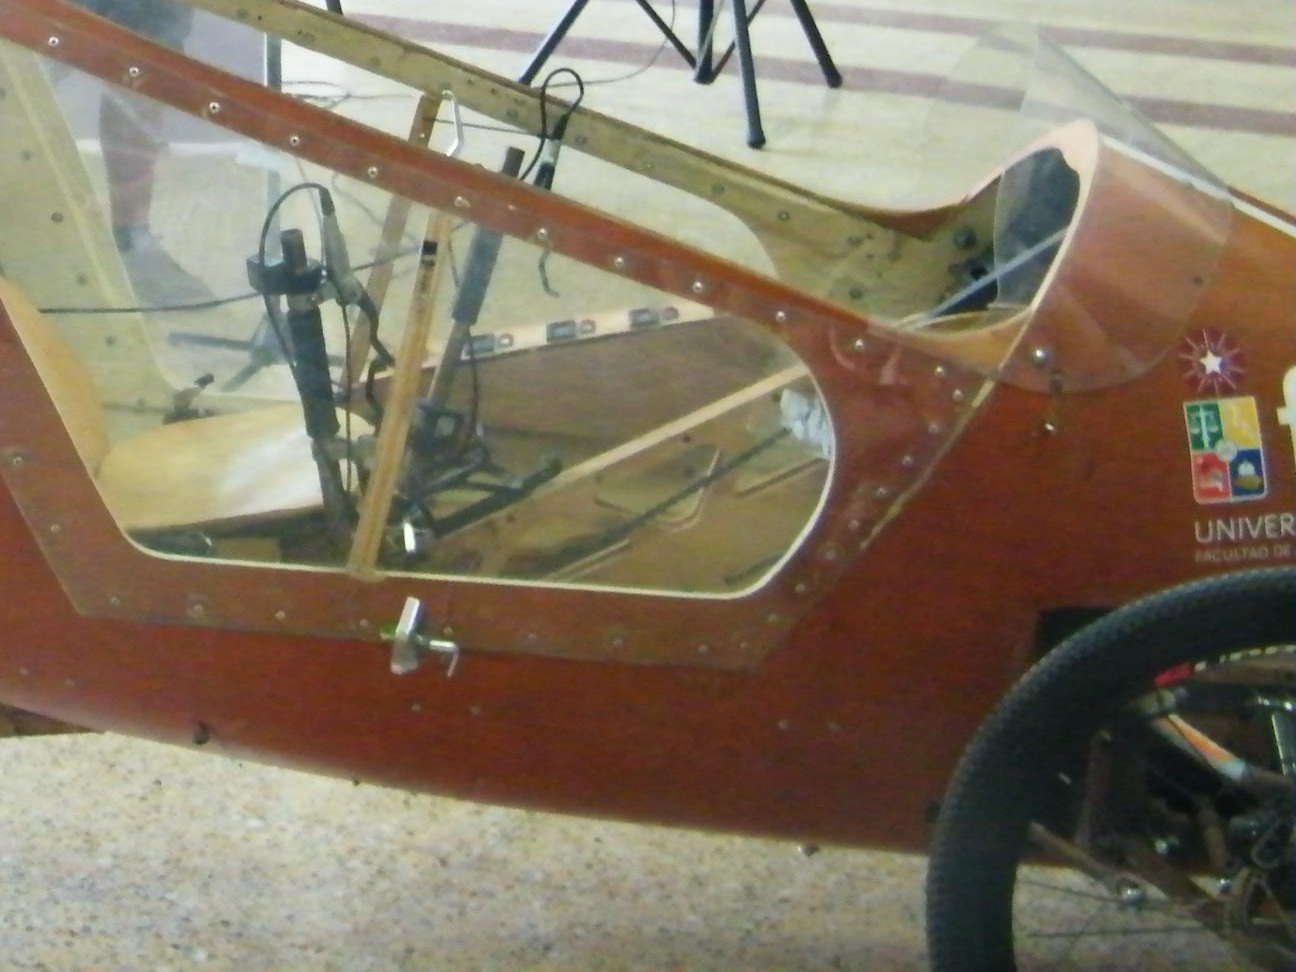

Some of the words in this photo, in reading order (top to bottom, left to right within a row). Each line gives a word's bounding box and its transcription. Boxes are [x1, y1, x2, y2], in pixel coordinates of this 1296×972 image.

[1194, 511, 1296, 544] UNIVER
[1195, 545, 1270, 565] FACULTAD
[1272, 543, 1292, 558] DE
